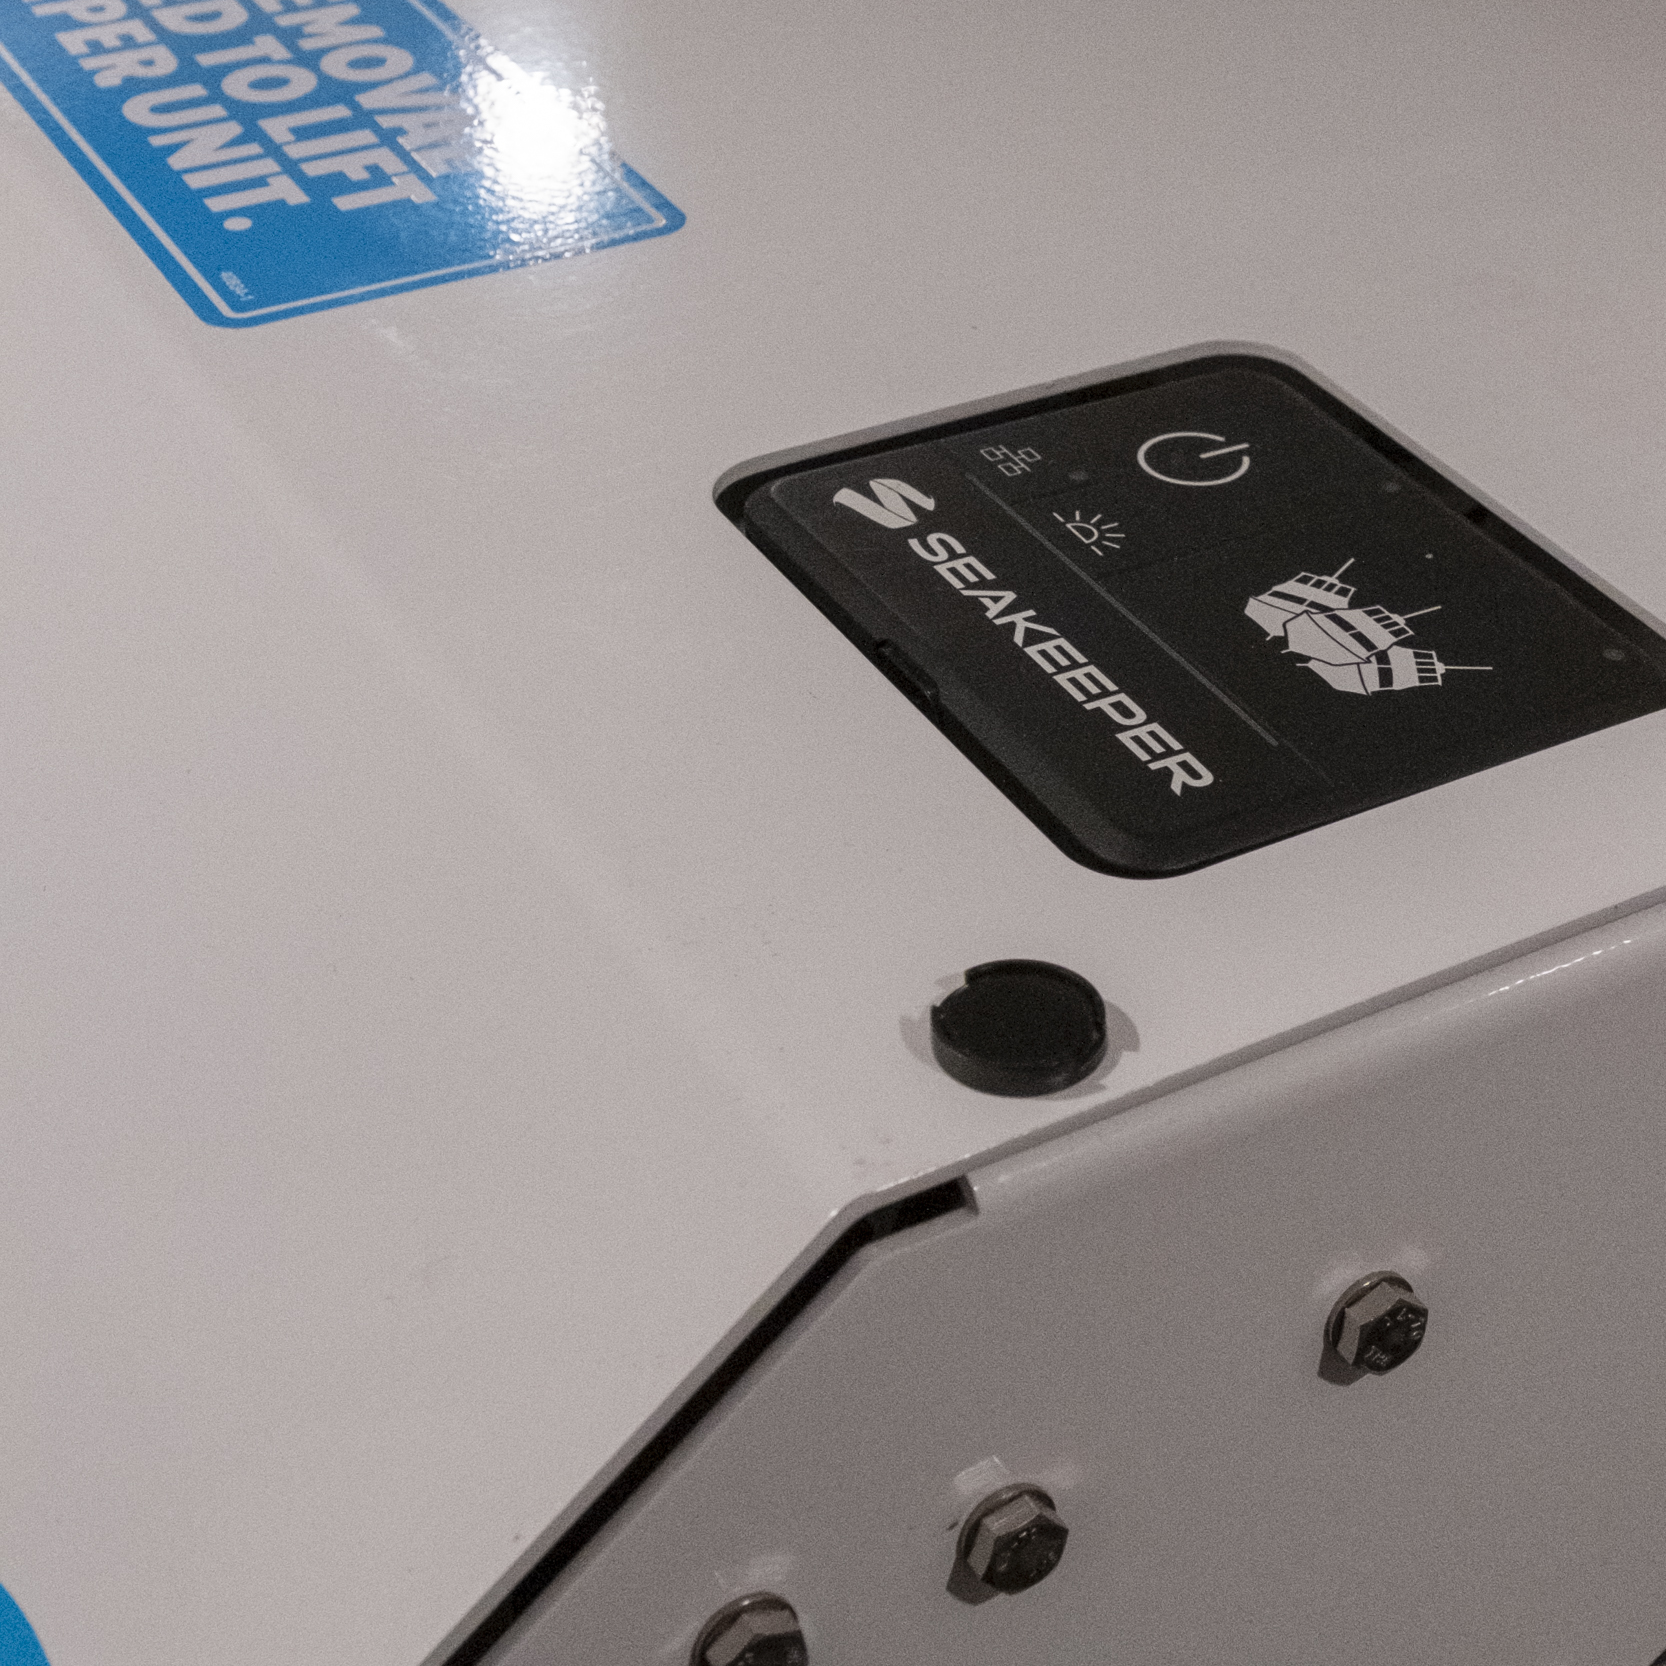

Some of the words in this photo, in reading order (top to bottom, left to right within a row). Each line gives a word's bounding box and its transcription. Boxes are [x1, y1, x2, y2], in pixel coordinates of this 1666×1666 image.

[121, 84, 310, 233] UNIT.
[195, 34, 319, 104] TO
[258, 103, 437, 212] LIFT
[908, 531, 1215, 797] SEAKEEPER
